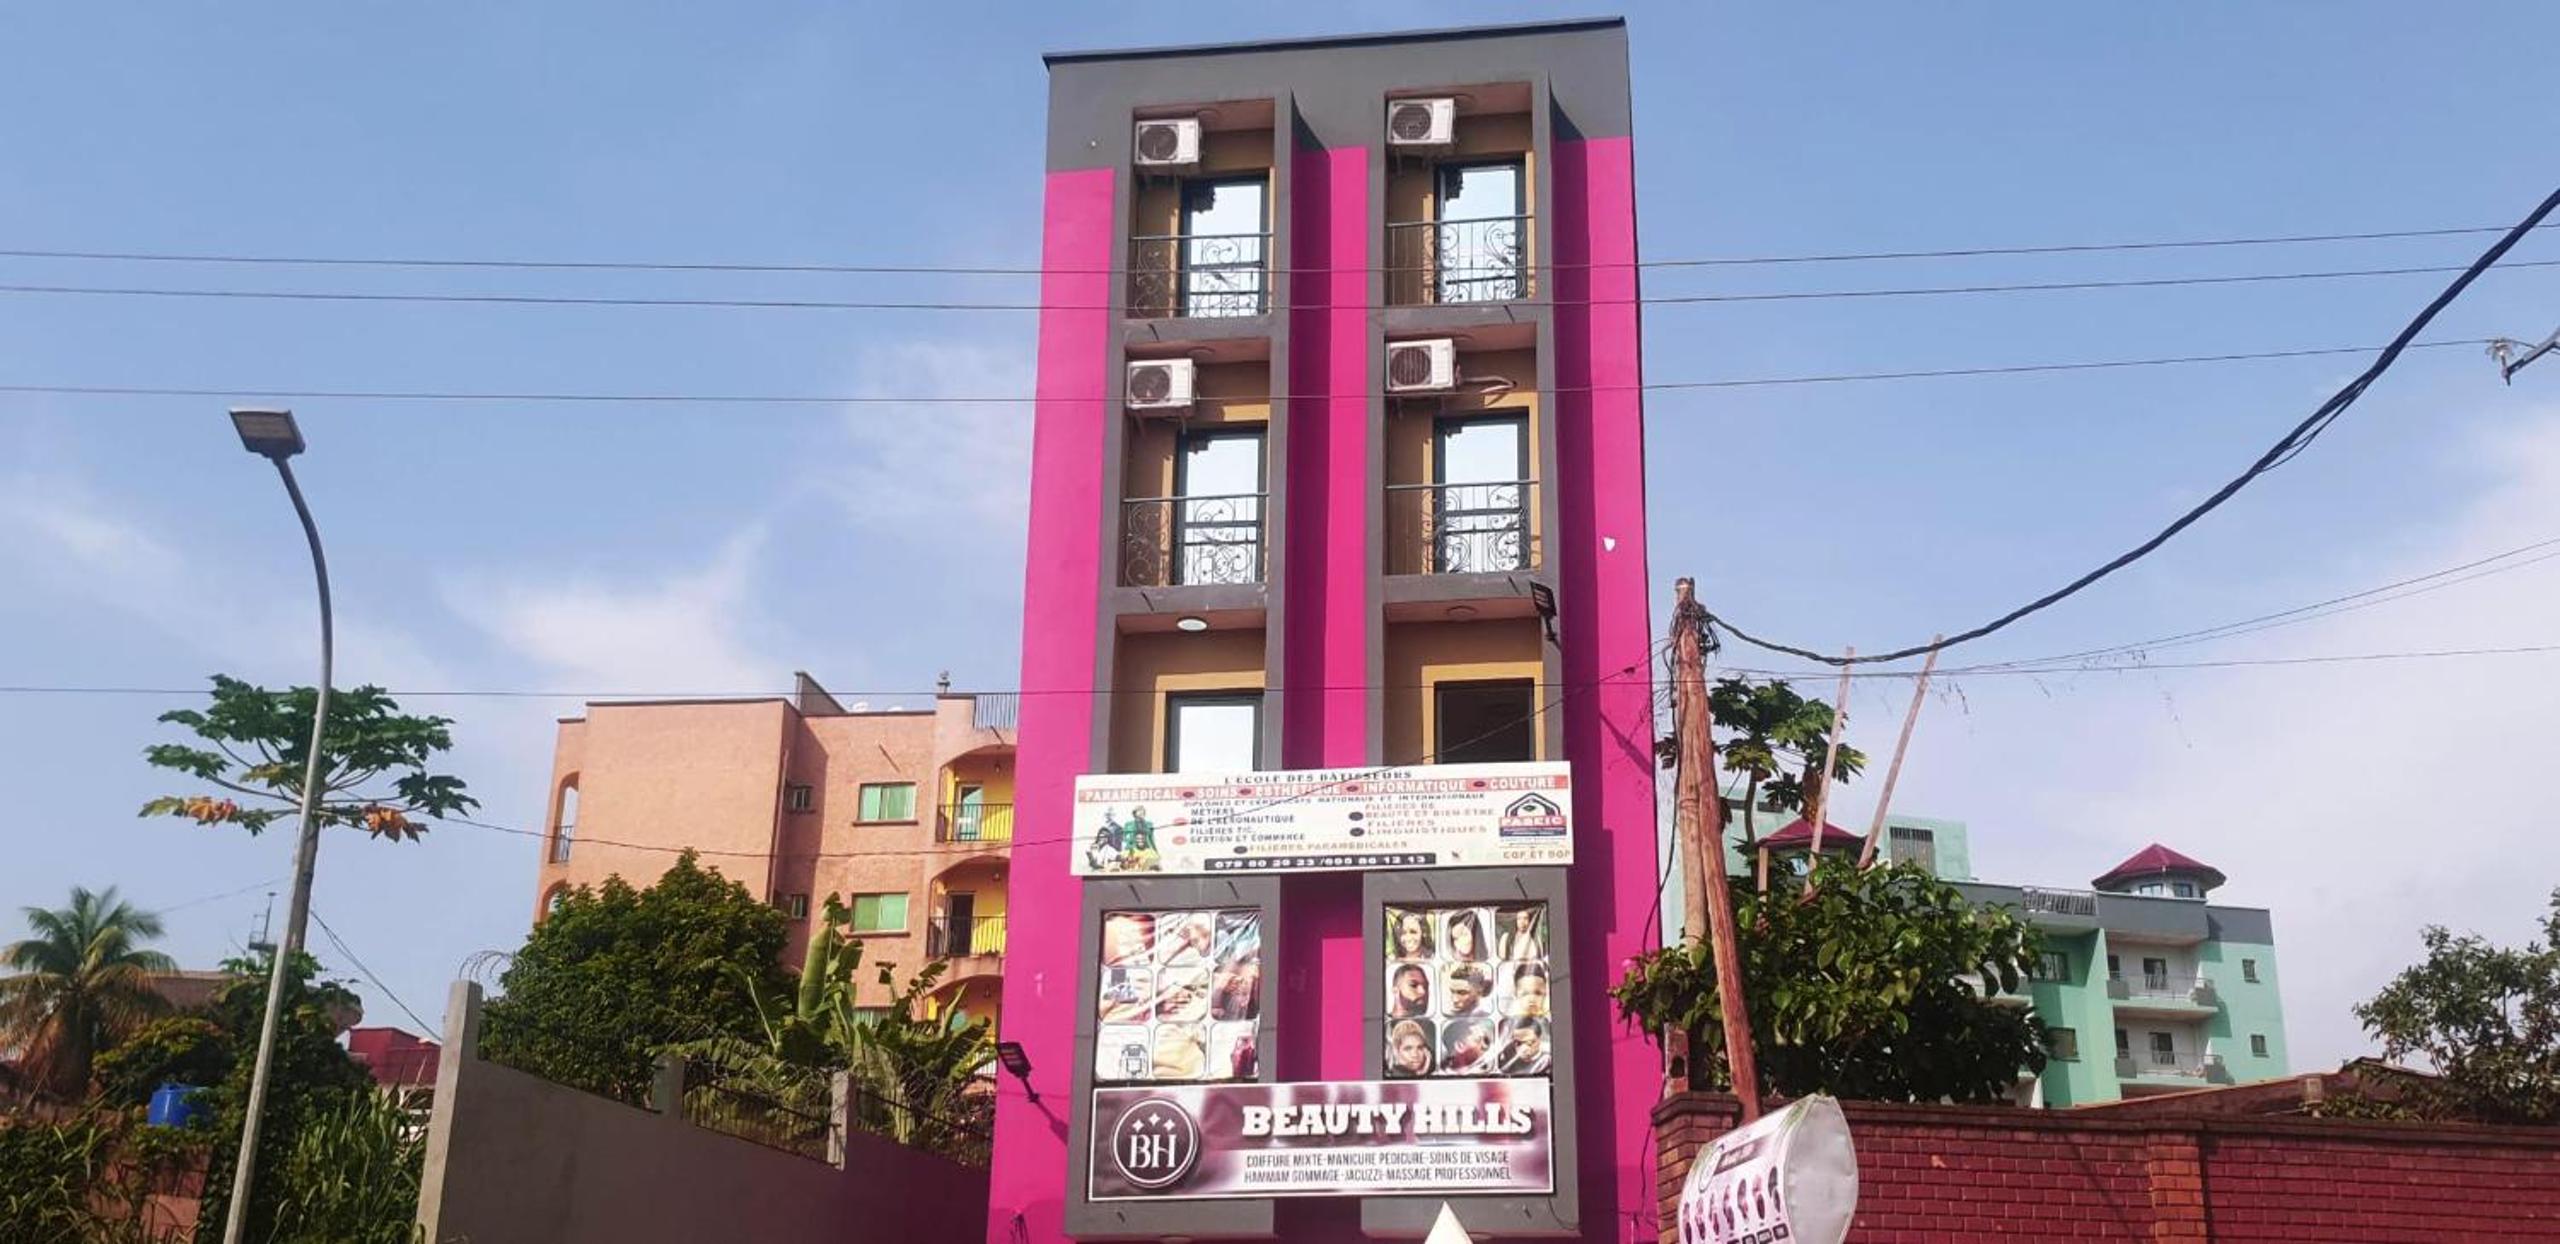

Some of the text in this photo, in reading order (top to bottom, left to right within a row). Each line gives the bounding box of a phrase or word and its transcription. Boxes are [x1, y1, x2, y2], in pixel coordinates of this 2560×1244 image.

[1287, 773, 1313, 782] DES
[1489, 776, 1556, 790] COUTURE
[1197, 786, 1238, 799] SOINS
[1363, 780, 1466, 794] INFORMATIQUE
[1085, 788, 1179, 801] PARAMEDICAL
[1251, 833, 1305, 842] COMMERCE
[1242, 1102, 1533, 1137] BEAUTY HILLS
[1128, 1134, 1178, 1169] BH
[1246, 1154, 1290, 1168] COIFFURE
[1460, 1151, 1472, 1164] DE
[1475, 1150, 1510, 1164] VISAGE
[1244, 1170, 1290, 1183] HAMMAM
[1435, 1166, 1512, 1181] PROFESSIONNEL
